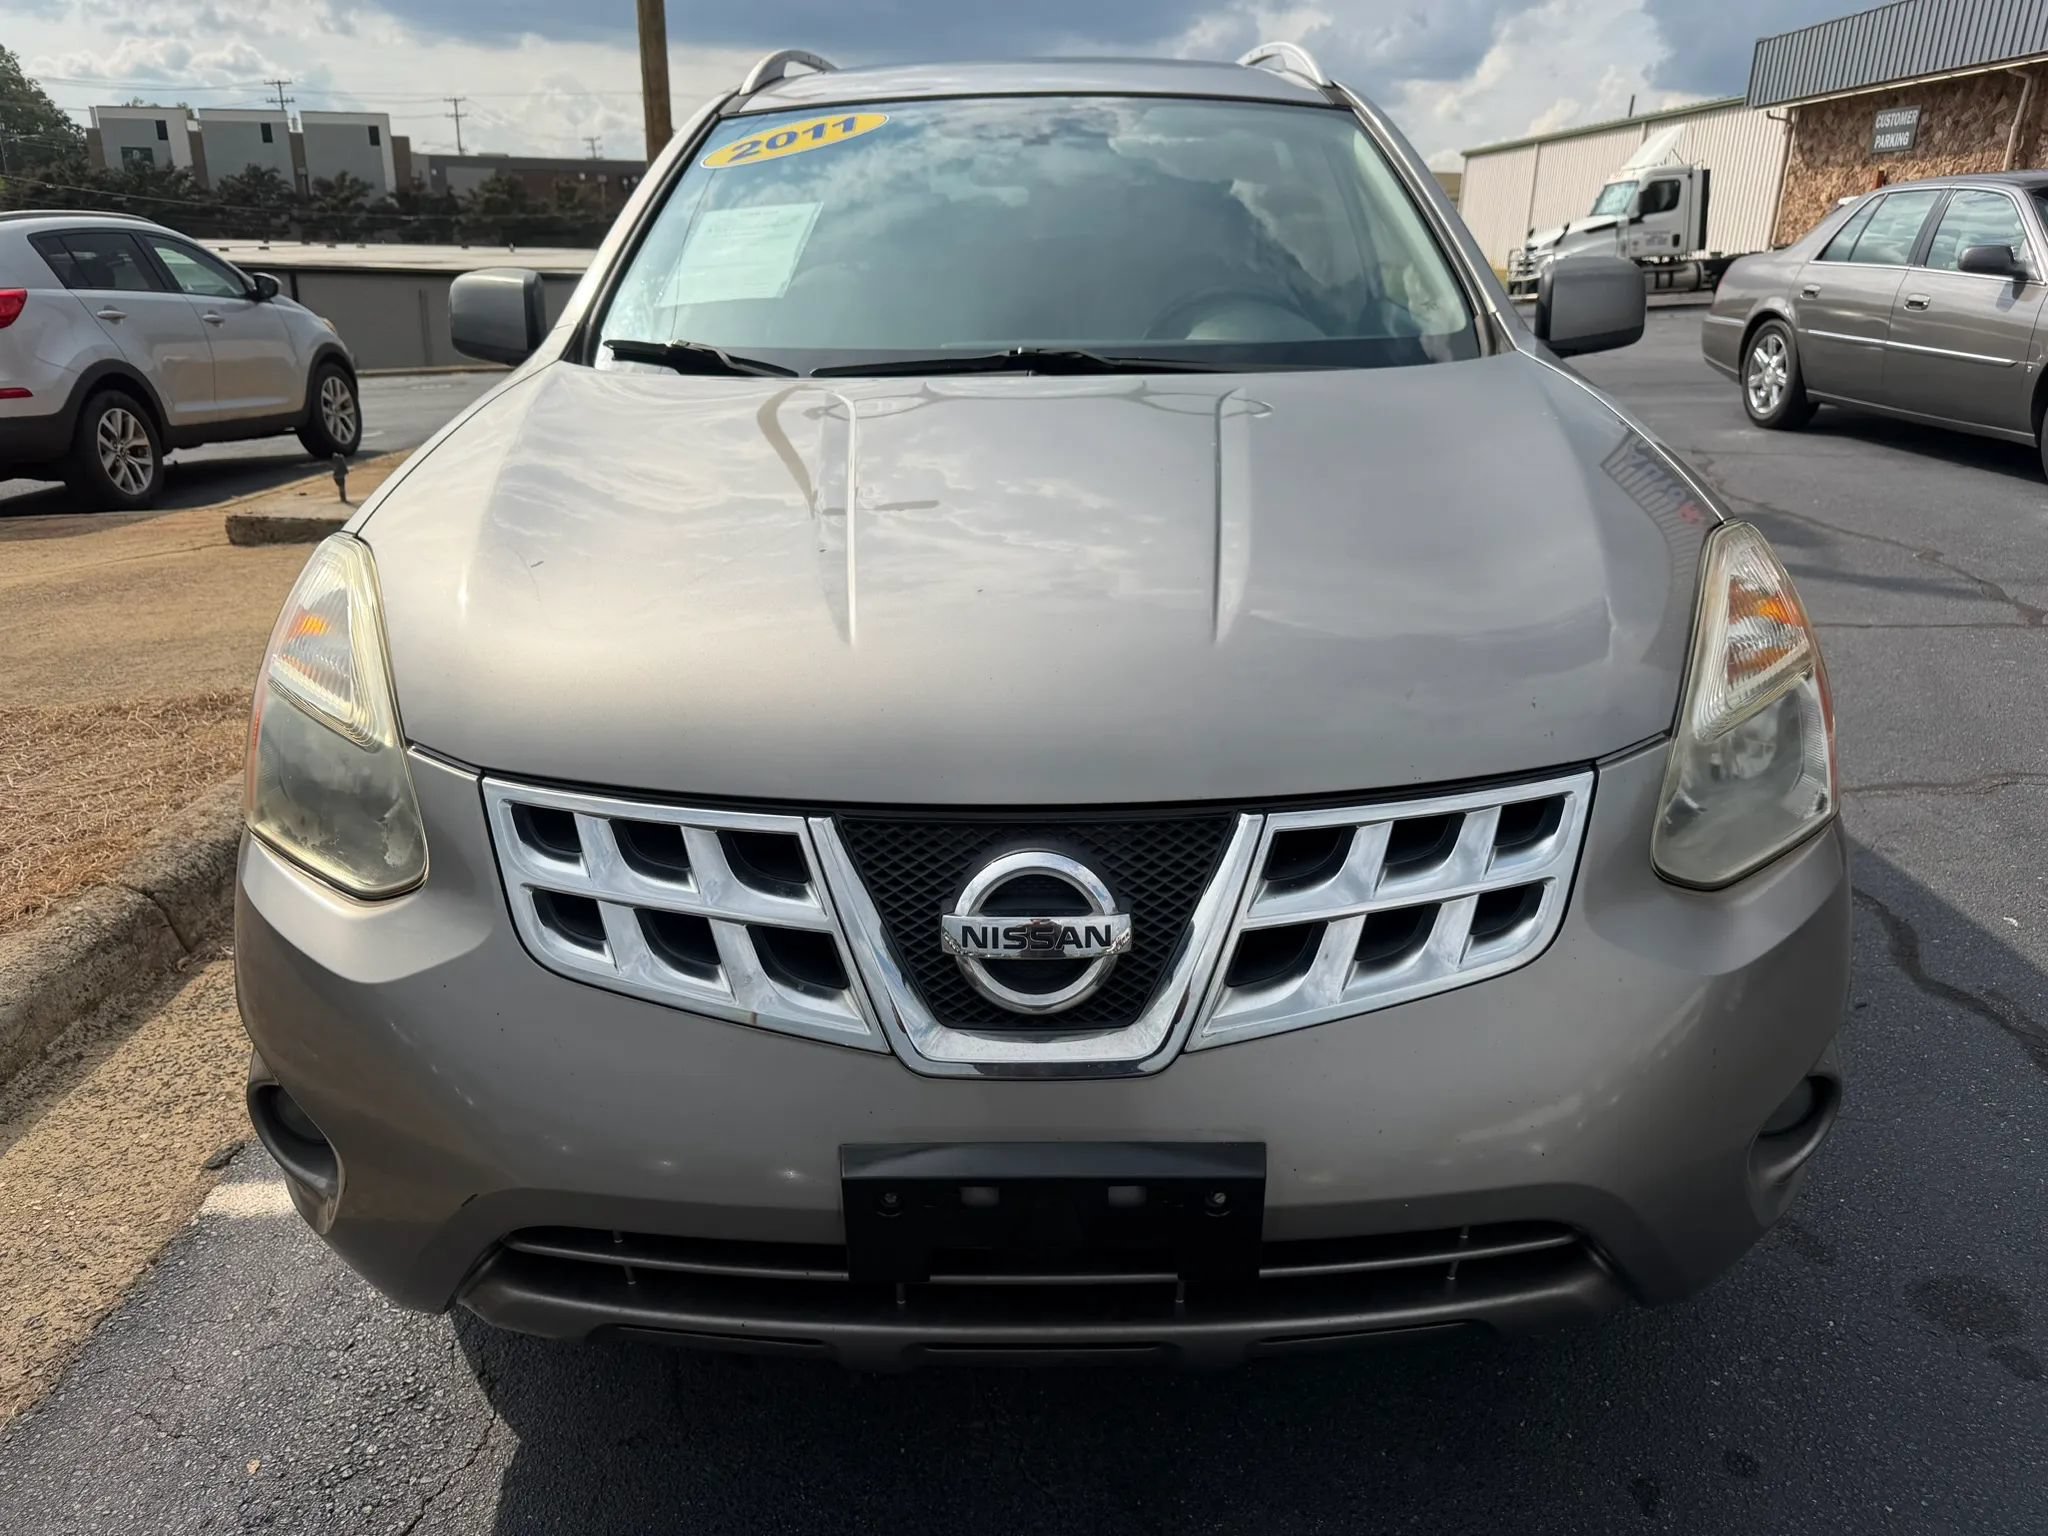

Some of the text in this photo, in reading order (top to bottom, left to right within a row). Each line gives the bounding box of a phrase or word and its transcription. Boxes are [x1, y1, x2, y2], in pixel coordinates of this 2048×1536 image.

[1875, 110, 1918, 128] CUSTOMER
[728, 116, 857, 162] 2011
[1874, 132, 1910, 149] PARKING
[961, 925, 1111, 950] NISSAN
